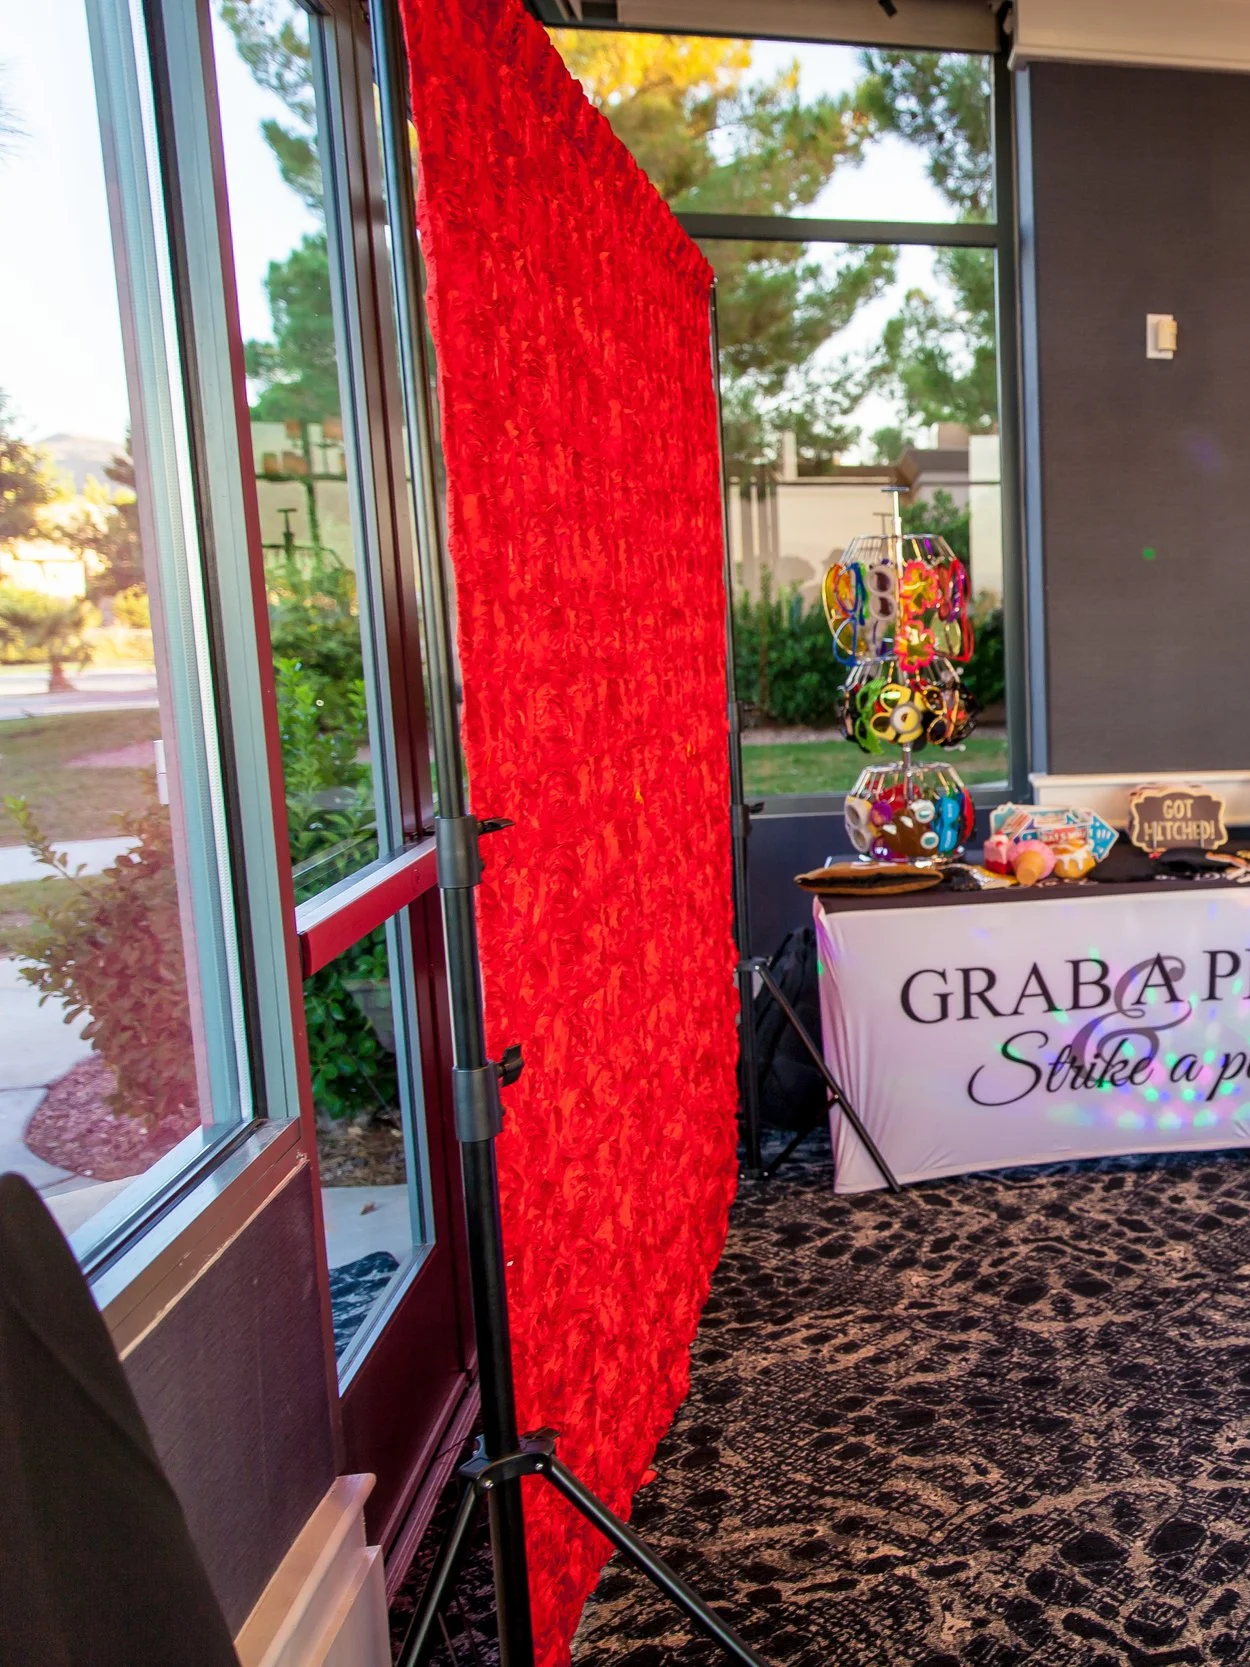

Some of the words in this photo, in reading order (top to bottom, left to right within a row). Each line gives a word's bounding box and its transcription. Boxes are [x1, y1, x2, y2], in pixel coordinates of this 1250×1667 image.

[1144, 820, 1216, 842] HITCHED!
[1163, 799, 1194, 820] GOT
[900, 958, 1112, 1024] GRAB
[1131, 953, 1185, 1006] A
[967, 1030, 1154, 1107] Strike
[1169, 1053, 1204, 1083] a
